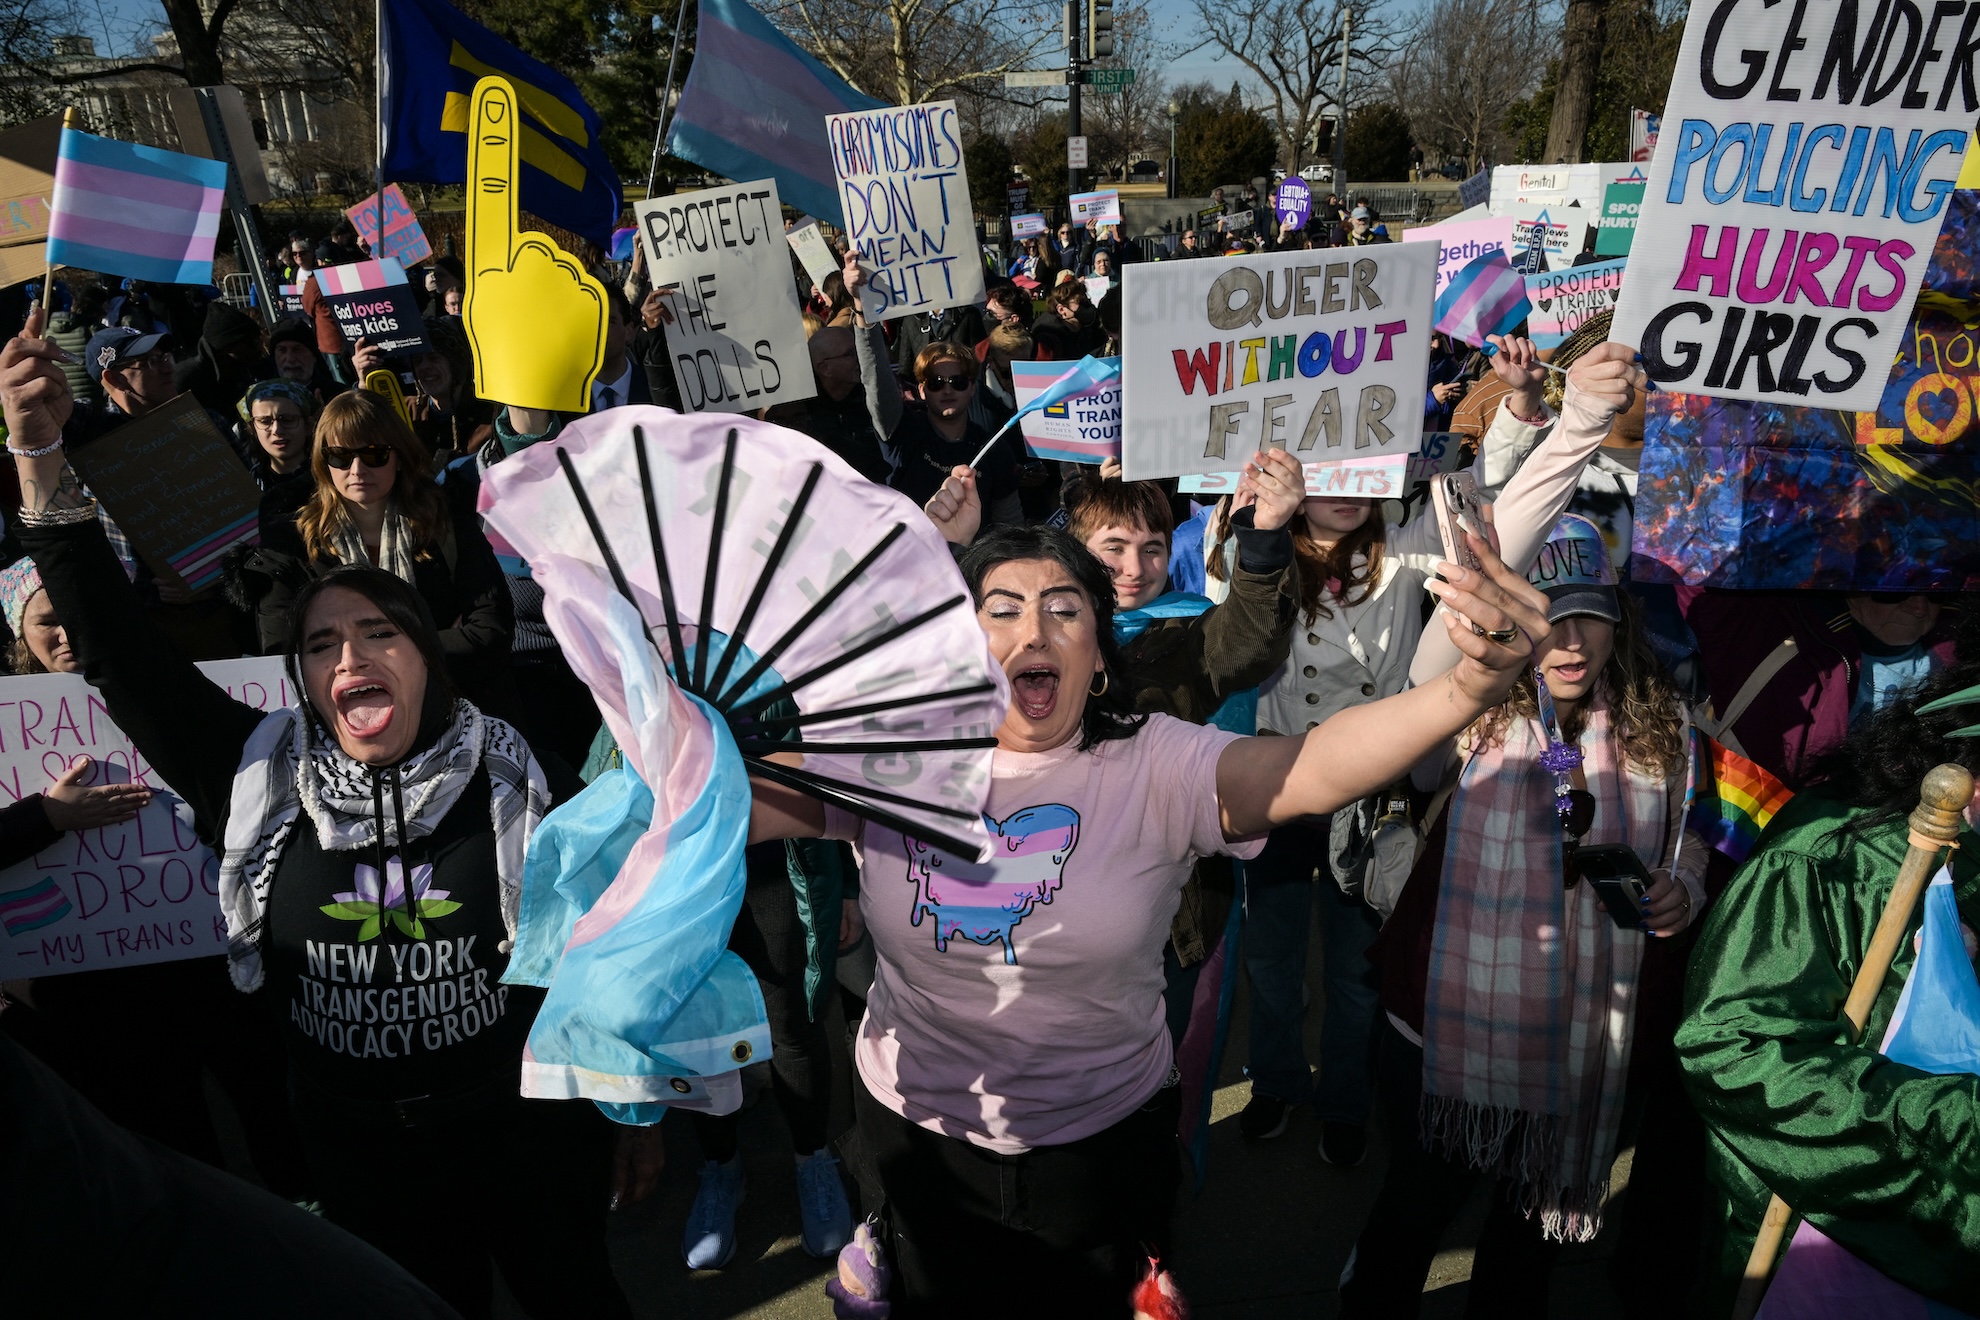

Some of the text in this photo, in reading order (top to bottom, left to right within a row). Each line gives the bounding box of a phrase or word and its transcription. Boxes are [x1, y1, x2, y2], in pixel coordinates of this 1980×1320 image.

[1701, 0, 1980, 112] GENDER
[1089, 71, 1122, 83] FIRST
[1097, 84, 1119, 93] UNIT
[830, 106, 961, 180] CHROMOSOMES
[1520, 173, 1556, 190] Genital
[1666, 118, 1968, 225] POLICING
[845, 172, 957, 240] DON'T
[1008, 188, 1028, 196] TRUMP
[1010, 195, 1027, 203] MUST
[1279, 198, 1308, 212] EQUALITY
[1280, 185, 1309, 199] LGBTQIA+
[1608, 203, 1641, 214] SPO
[353, 191, 411, 236] EQUAL
[644, 190, 771, 260] PROTECT
[1516, 224, 1569, 238] Tra Jews
[855, 225, 946, 268] MEAN
[1439, 239, 1503, 267] gether
[1512, 234, 1569, 247] belo here
[1529, 250, 1539, 269] TEAM
[867, 256, 958, 314] SHIT
[1538, 267, 1624, 299] PROTECT
[1673, 224, 1917, 313] HURTS
[334, 300, 394, 320] God loves
[658, 273, 727, 337] THE
[1207, 258, 1383, 330] QUEER
[1556, 289, 1607, 312] TRANS
[341, 316, 399, 336] trans kids
[1172, 320, 1407, 397] WITHOUT
[1640, 302, 1878, 398] GIRLS
[677, 339, 781, 411] DOLLS
[1076, 389, 1122, 406] PROT
[1076, 408, 1122, 423] TRAN
[1078, 425, 1122, 440] YOUT
[1203, 384, 1397, 460] FEAR
[124, 431, 179, 462] Seneca
[174, 442, 226, 470] Selma
[128, 458, 238, 526] and Stonewall
[1200, 468, 1391, 495] SENTS
[160, 505, 192, 530] right
[195, 486, 238, 508] here
[152, 501, 245, 557] and right now
[0, 693, 132, 752] TRAN
[97, 919, 194, 957] TRANS
[306, 935, 477, 984] NEW YORK
[298, 968, 490, 1024] TRANSGENDER
[291, 985, 509, 1059] ADVOCACY GROUP
